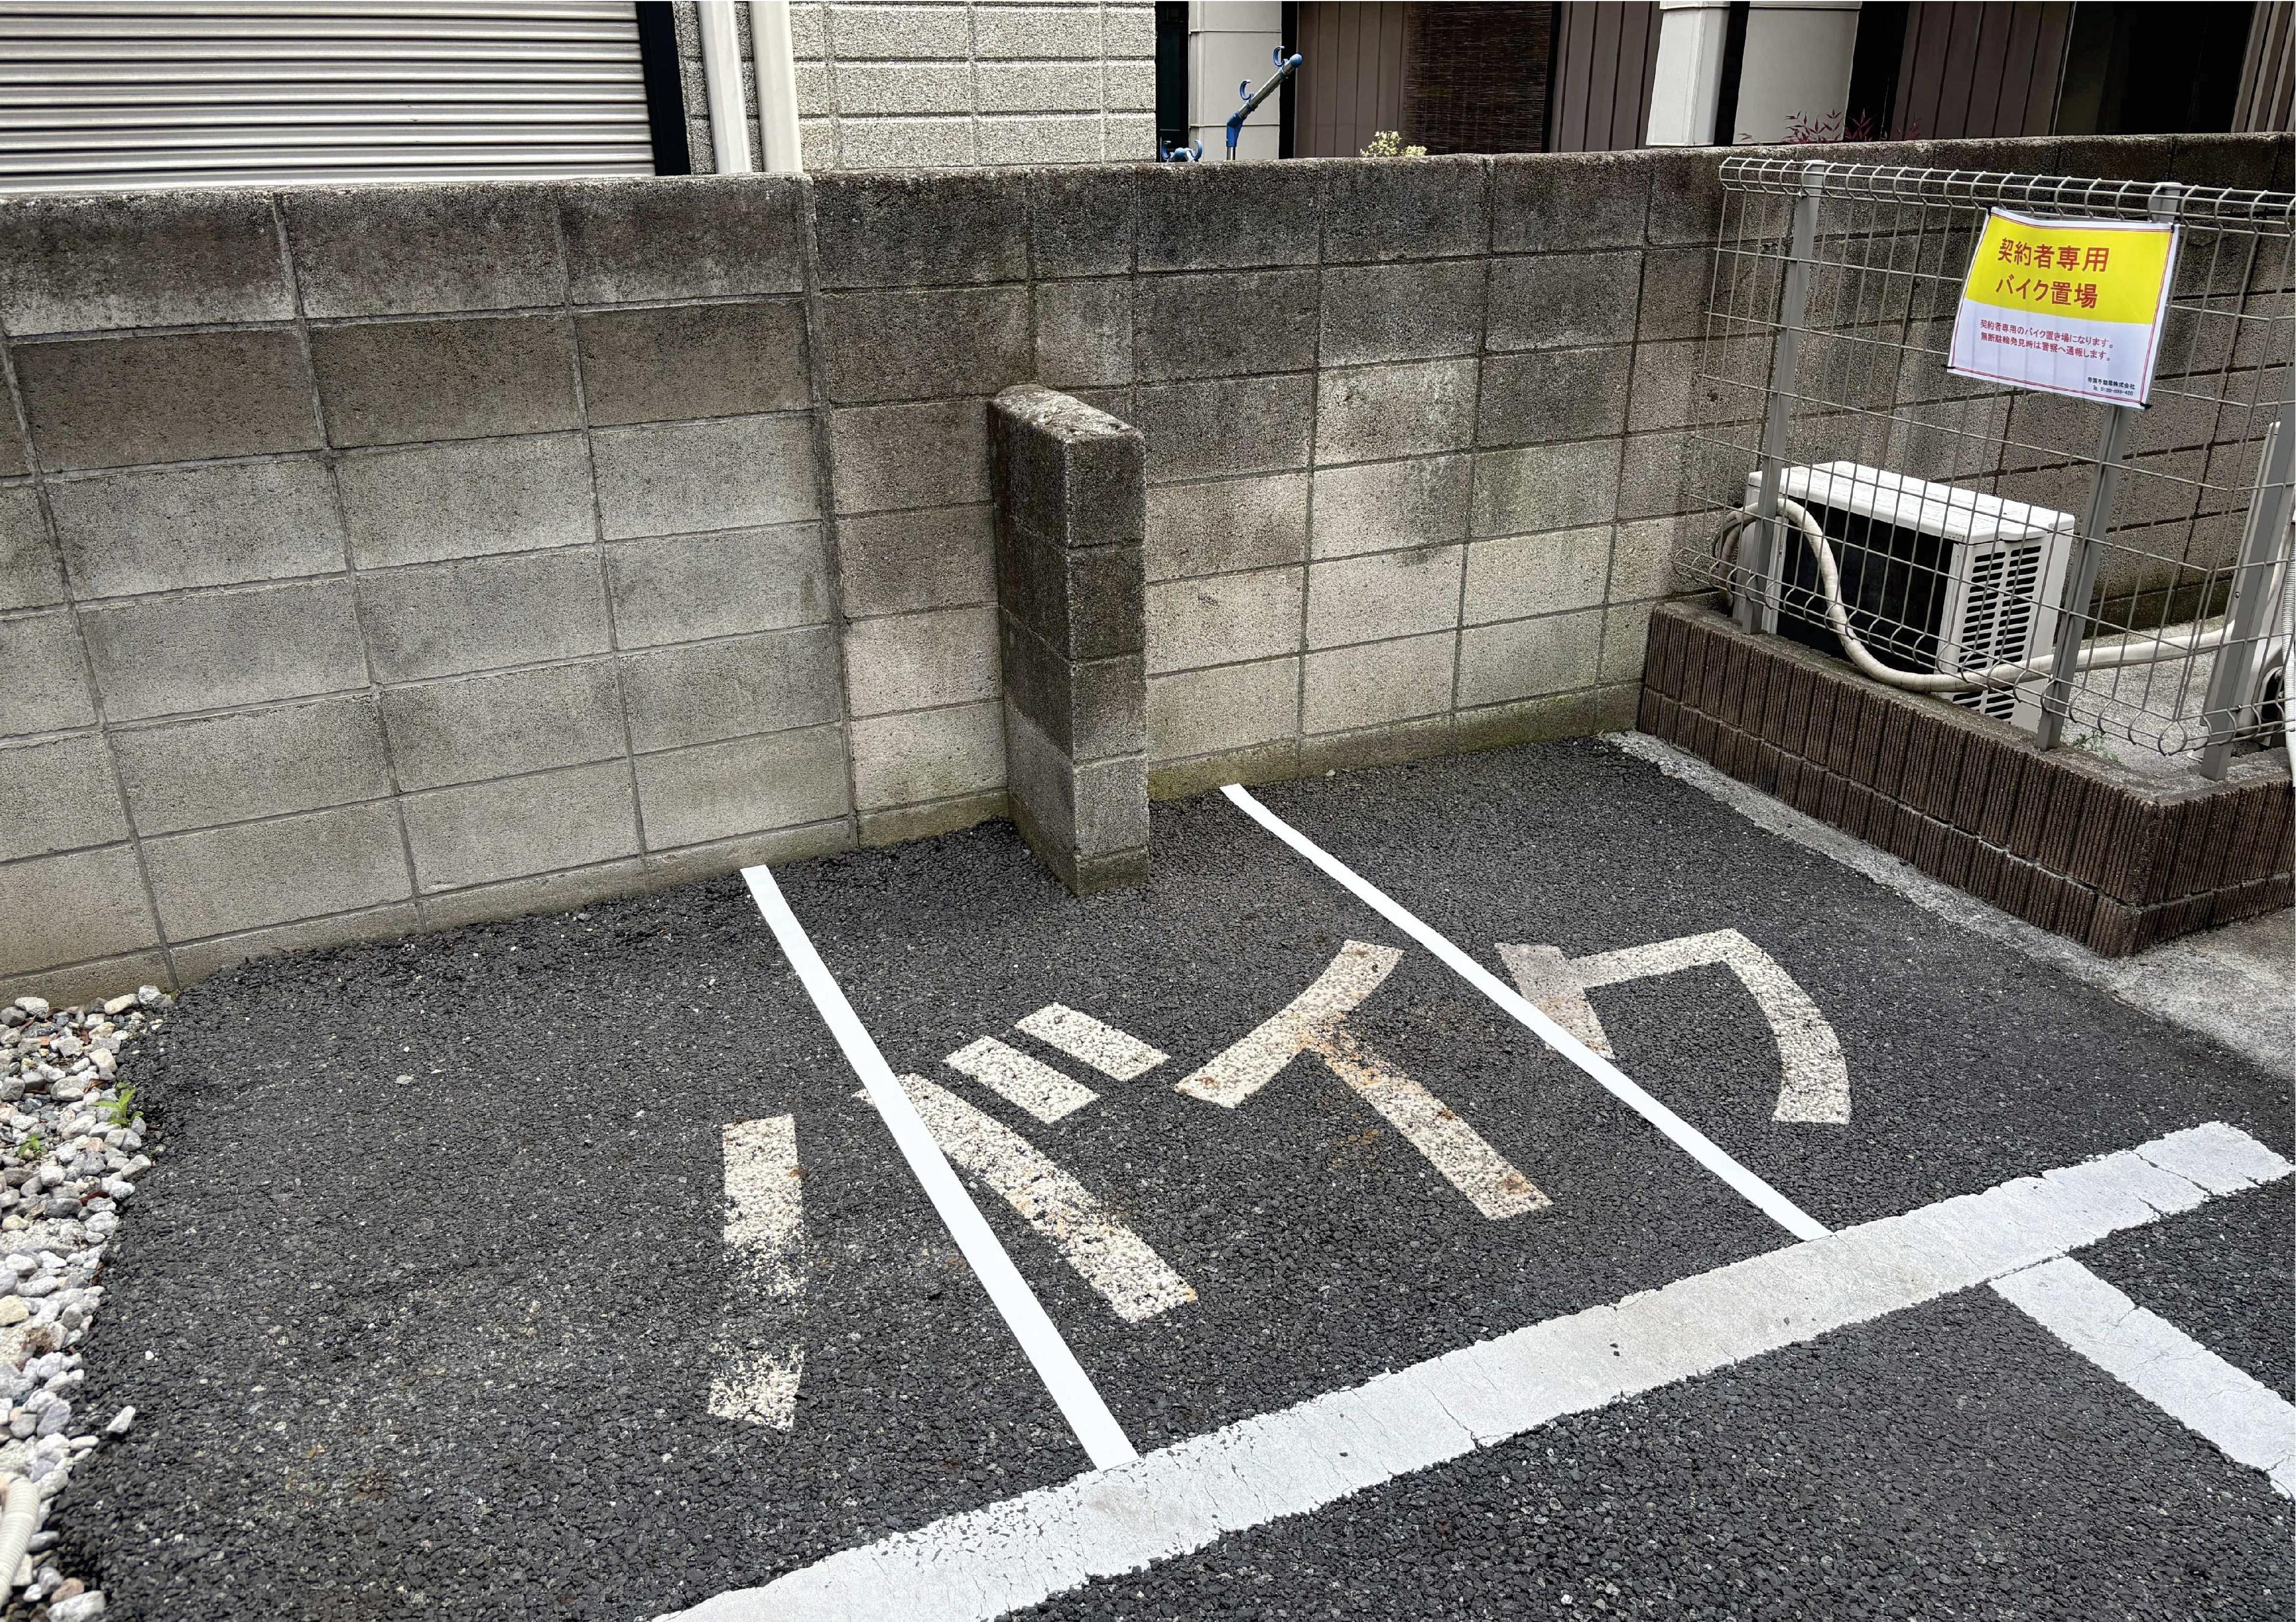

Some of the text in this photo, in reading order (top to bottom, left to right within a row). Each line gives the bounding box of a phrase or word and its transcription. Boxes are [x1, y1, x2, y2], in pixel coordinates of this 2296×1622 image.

[1998, 237, 2110, 273] 契約者専用
[1996, 273, 2098, 310] バイク置場
[1980, 319, 2114, 349] 契約者専用のバイク置き場になります。
[1980, 331, 2111, 362] 無断駐輪発見時は警察へ通報します。
[706, 927, 1853, 1432] バイク
